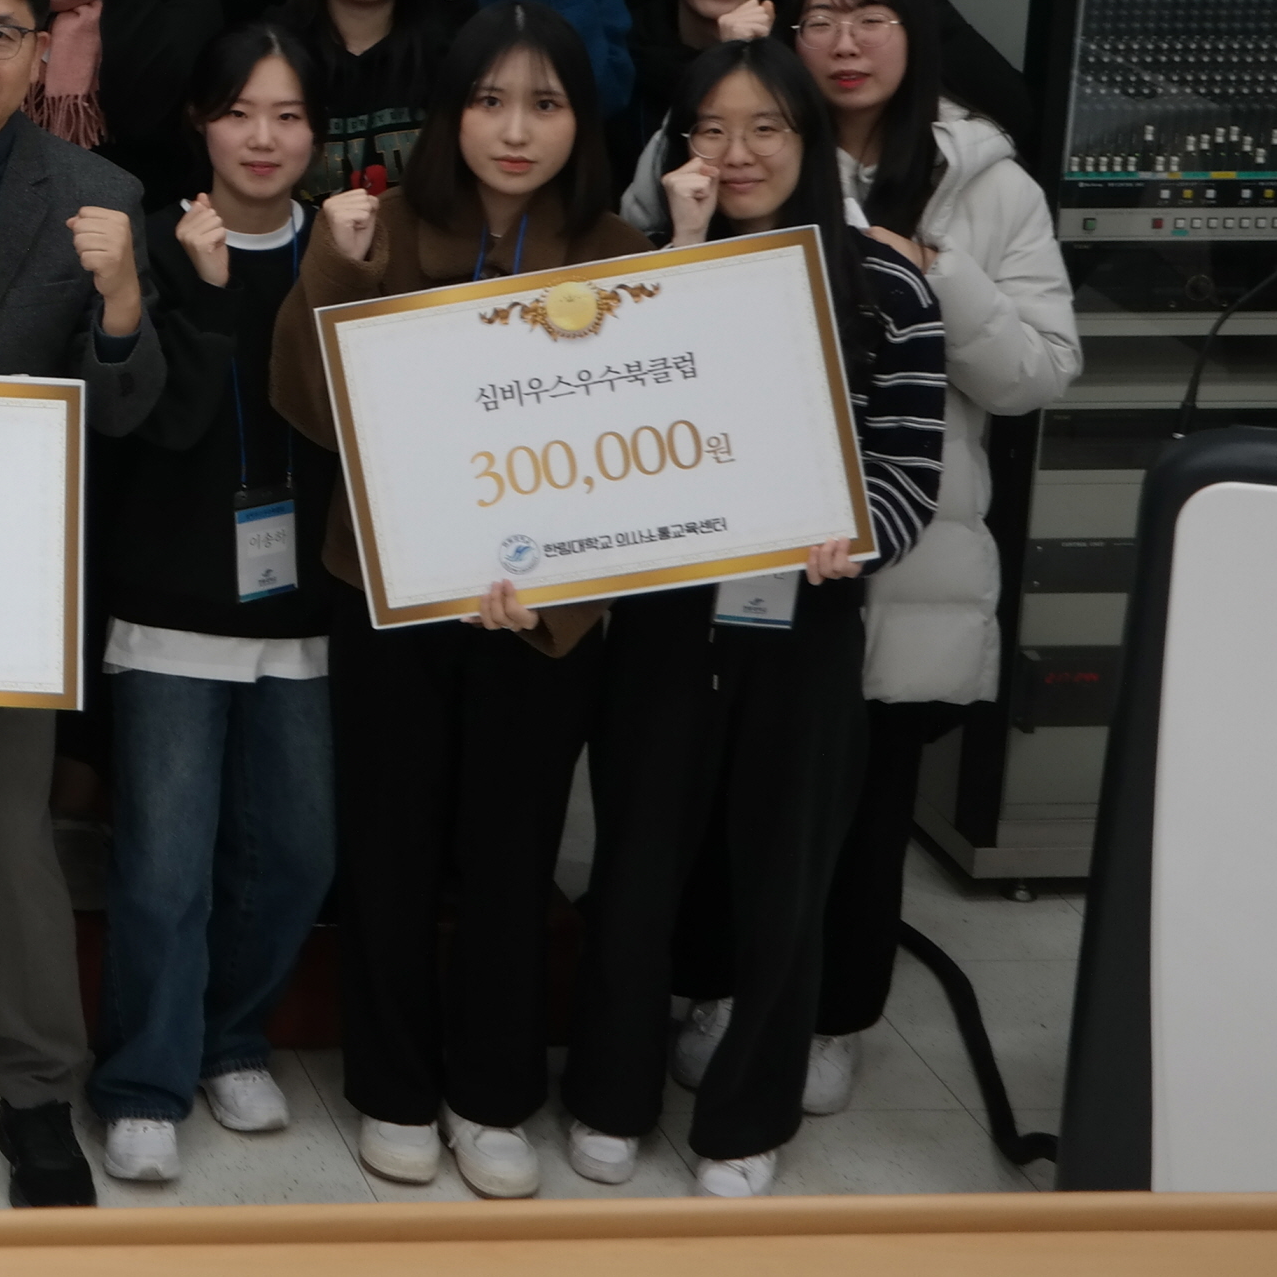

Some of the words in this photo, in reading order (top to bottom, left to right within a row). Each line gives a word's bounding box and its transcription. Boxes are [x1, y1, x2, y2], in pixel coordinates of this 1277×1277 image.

[474, 350, 699, 413] 심비우스우수북클럽
[469, 419, 736, 508] 300,000원
[542, 533, 612, 559] 한림대학교
[614, 516, 728, 550] 의사소통교육센터
